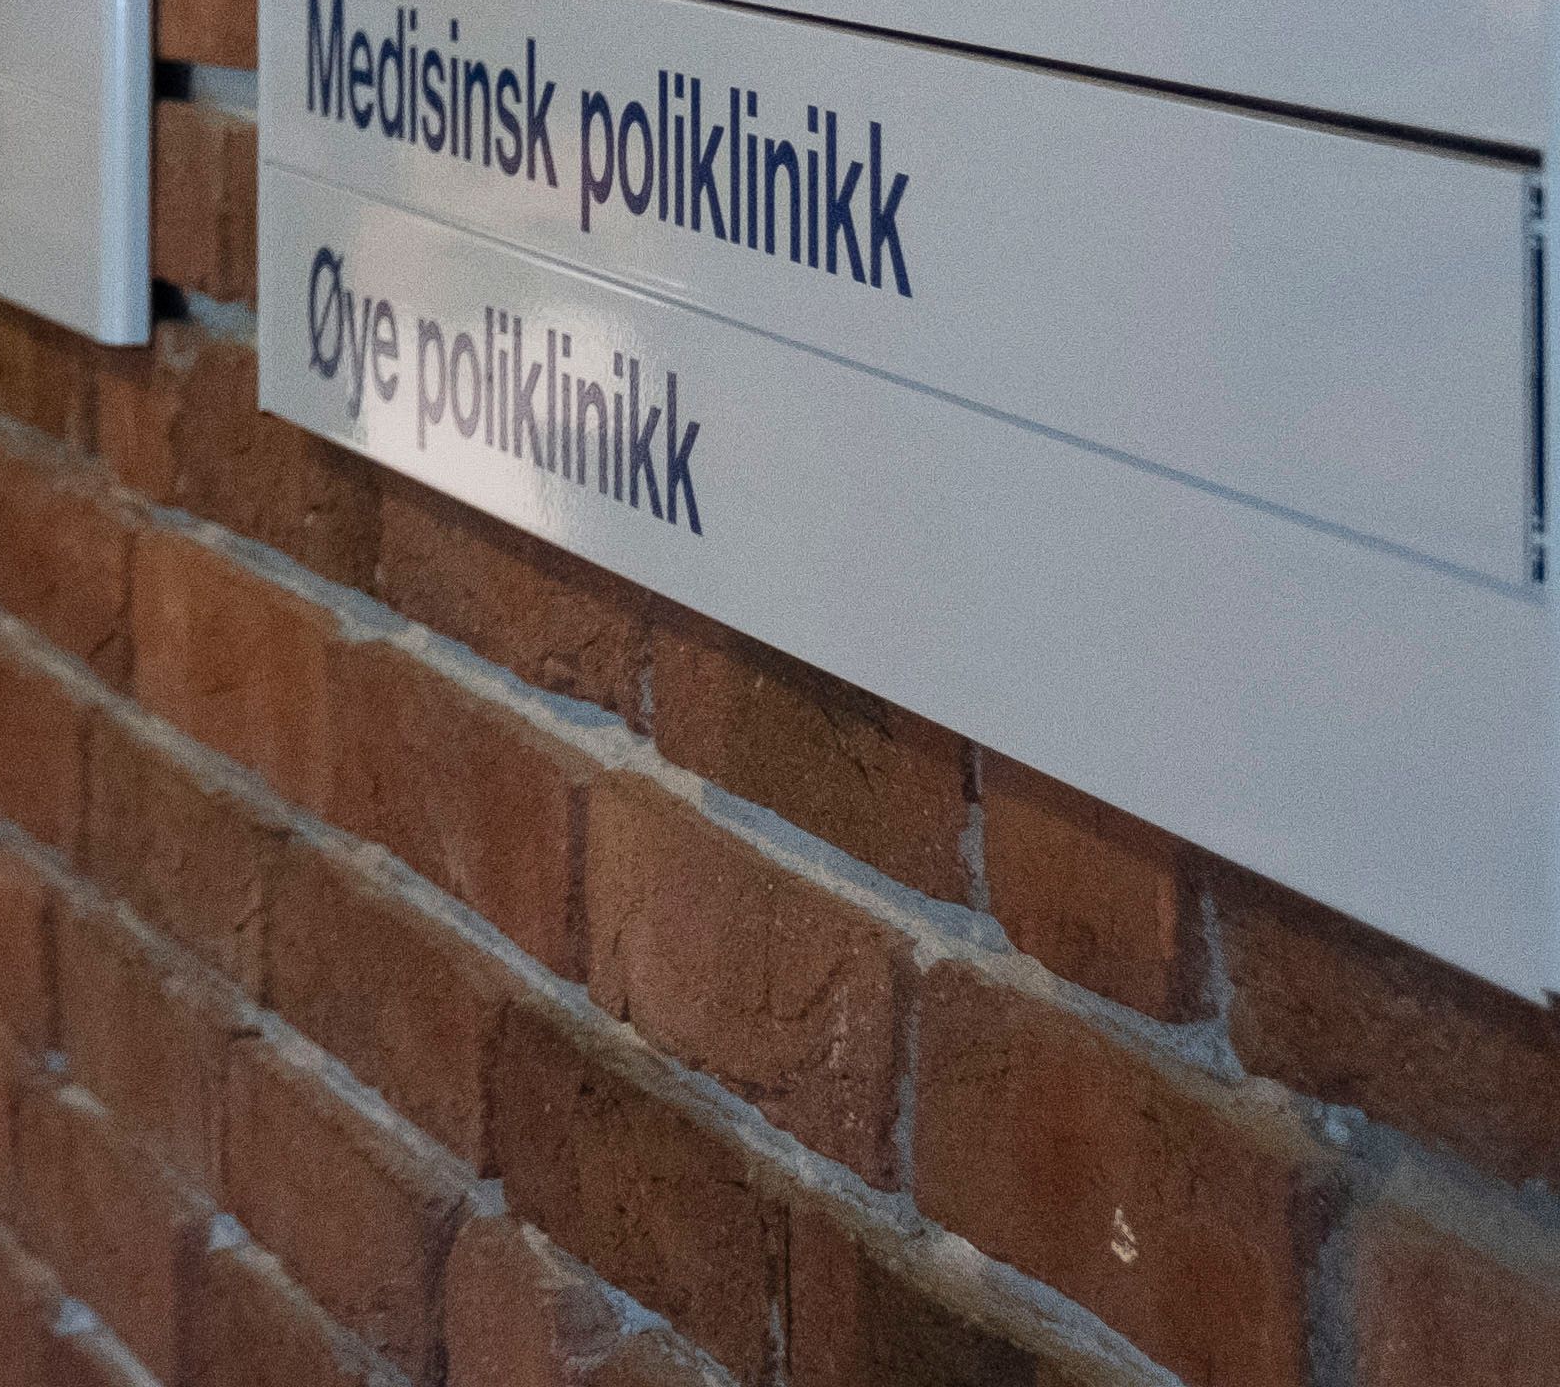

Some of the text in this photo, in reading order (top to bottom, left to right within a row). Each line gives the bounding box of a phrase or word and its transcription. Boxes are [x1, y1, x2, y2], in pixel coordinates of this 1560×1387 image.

[576, 69, 913, 299] poliklinikk
[307, 245, 705, 537] Øye poliklinikk
